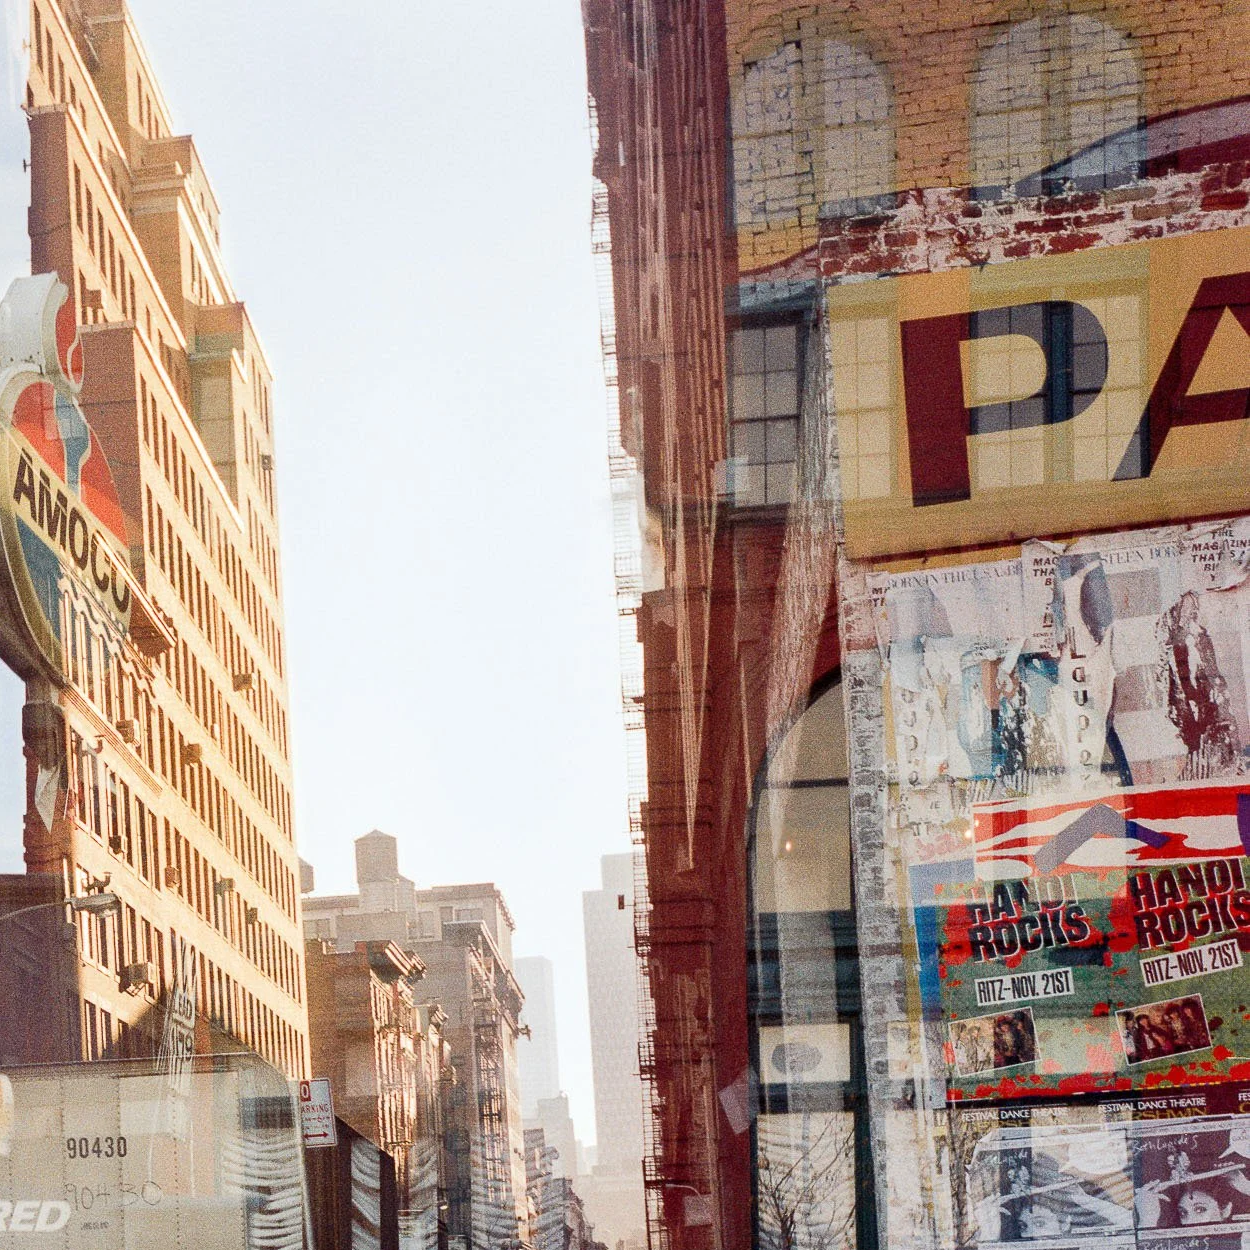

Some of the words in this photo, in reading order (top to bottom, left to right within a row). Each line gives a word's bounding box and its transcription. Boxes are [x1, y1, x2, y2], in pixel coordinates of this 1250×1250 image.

[13, 448, 131, 613] AMOCO
[1127, 857, 1245, 912] HANOI
[967, 874, 1080, 925] HANOI
[1134, 890, 1250, 950] ROCKS
[967, 905, 1091, 963] ROCKS
[1211, 947, 1241, 970] 21ST
[1043, 971, 1070, 995] 21ST
[301, 1103, 330, 1114] ARKING
[1000, 1109, 1030, 1120] DANCE
[1031, 1106, 1068, 1118] THEATRE
[1138, 1099, 1168, 1111] DANCE
[1170, 1096, 1207, 1108] THEATRE
[66, 1136, 128, 1159] 90430
